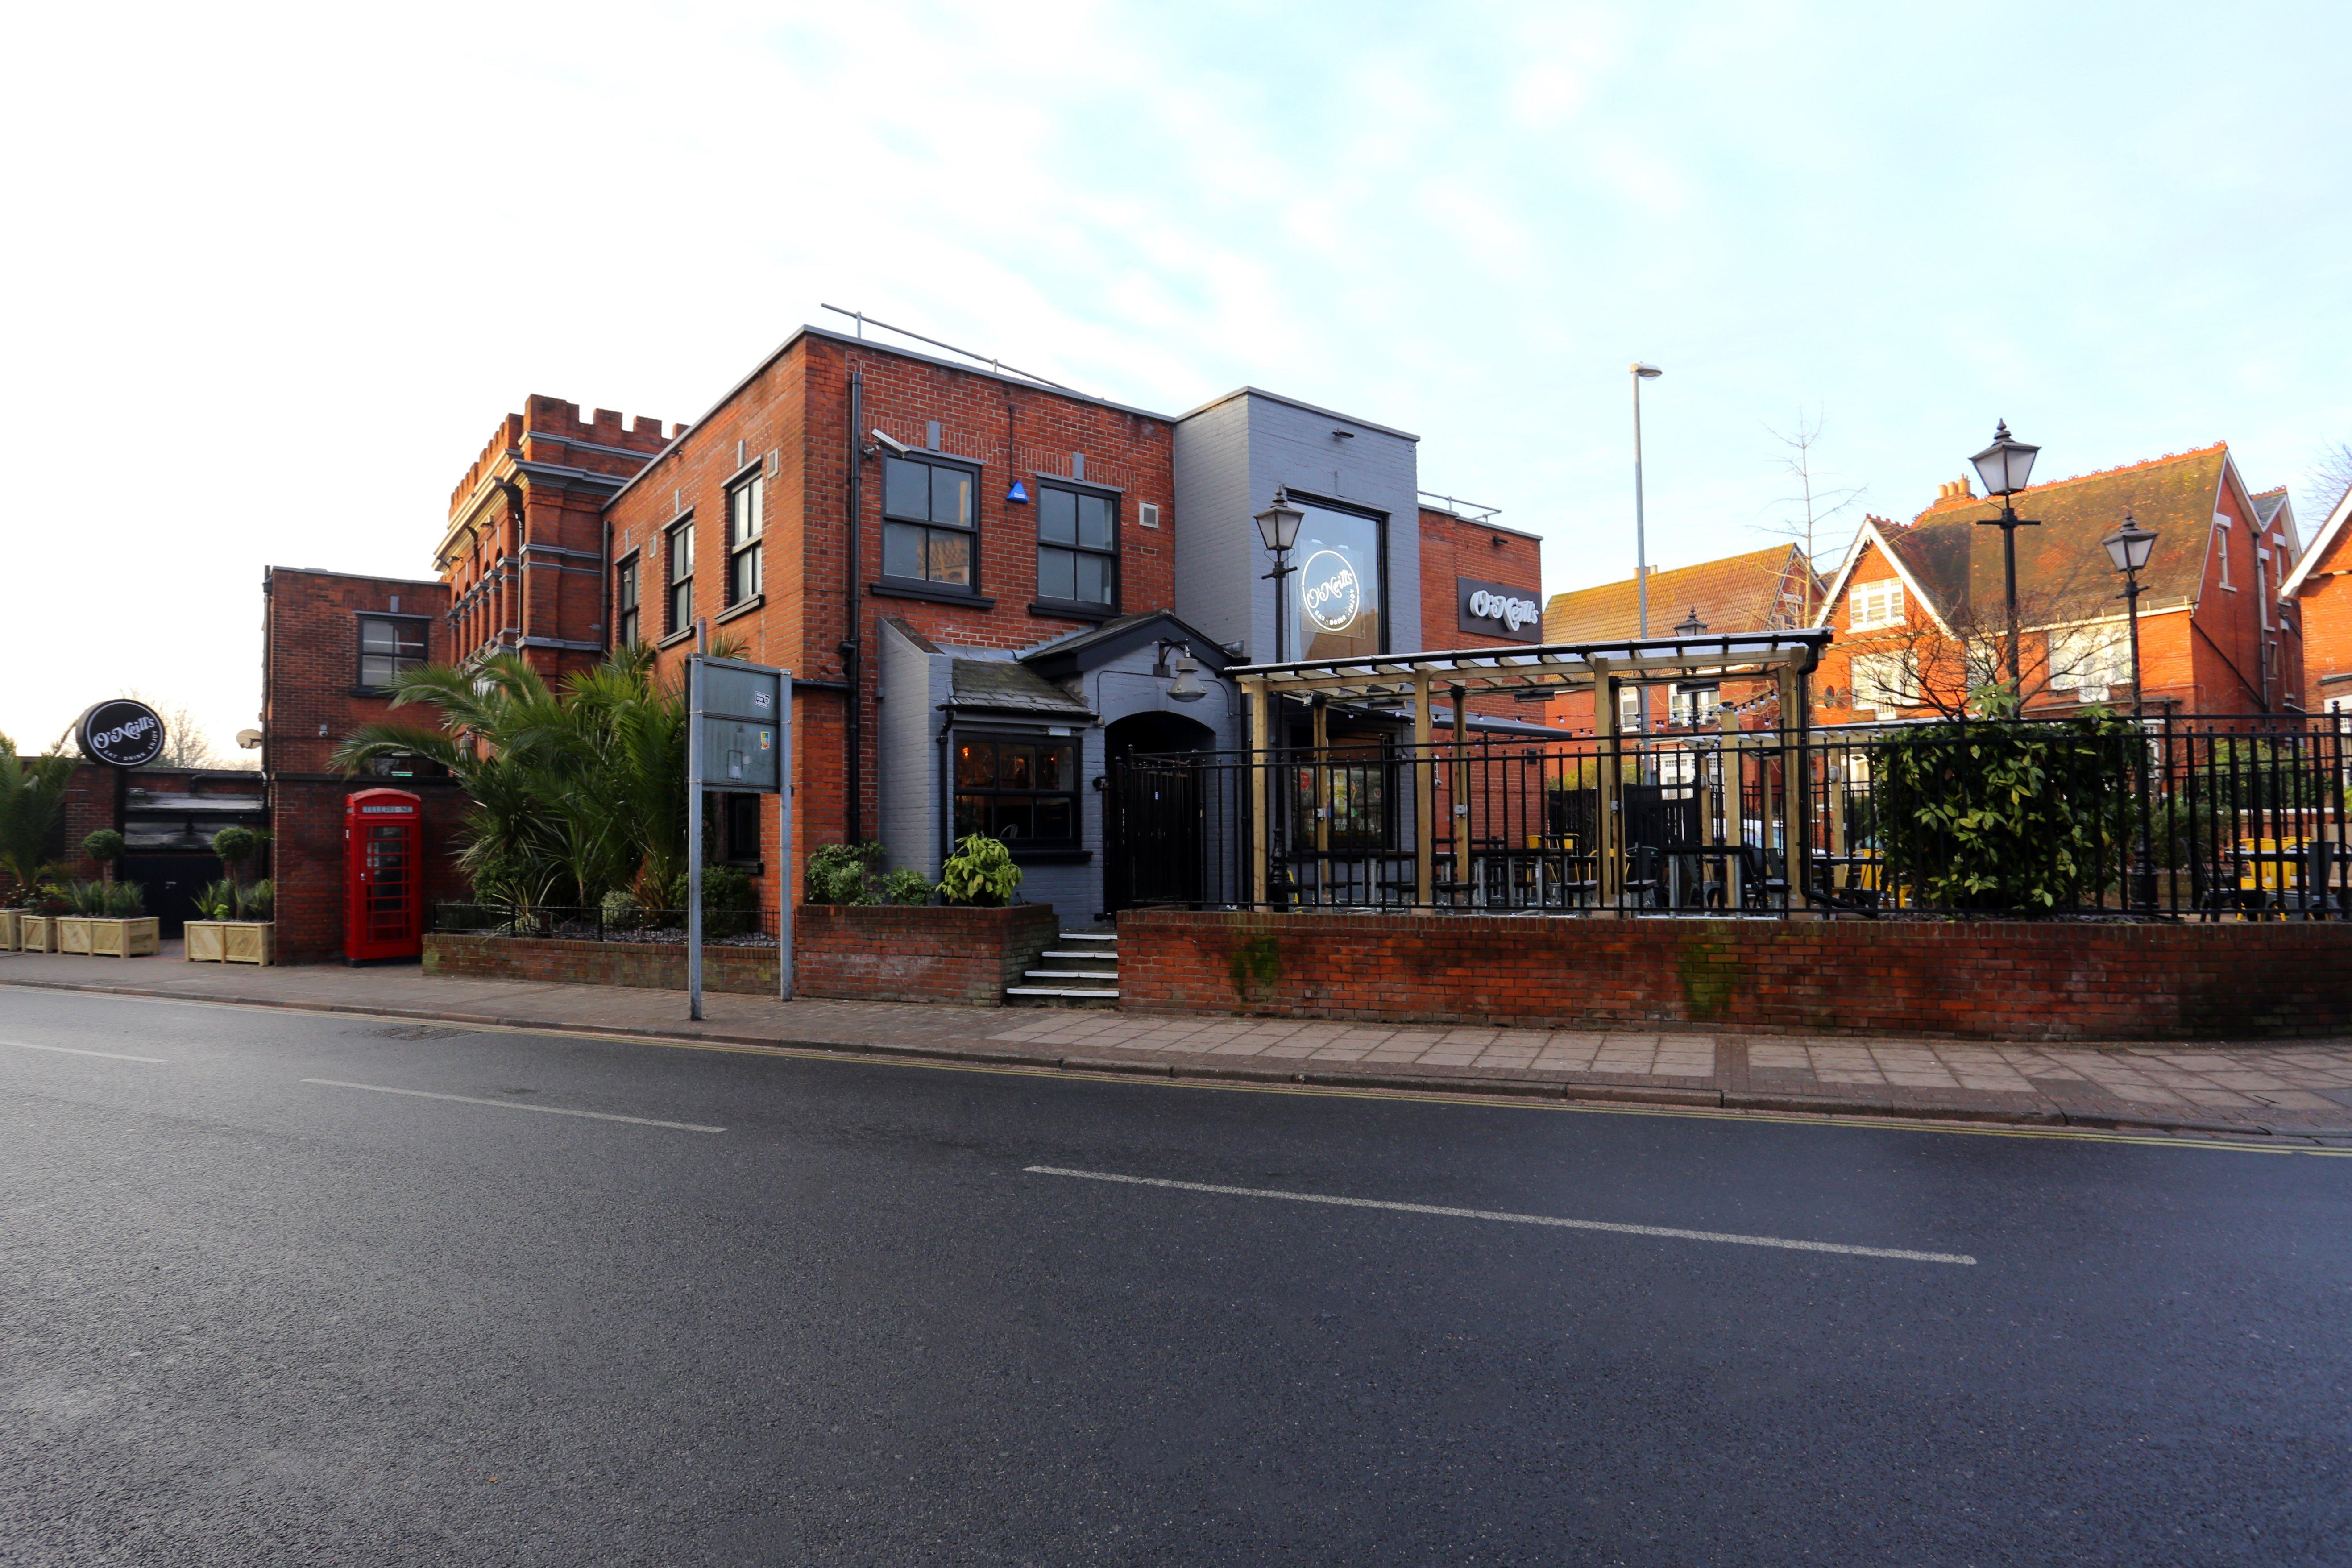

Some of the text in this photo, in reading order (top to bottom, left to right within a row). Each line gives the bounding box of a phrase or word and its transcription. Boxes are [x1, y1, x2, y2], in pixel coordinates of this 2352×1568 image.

[1307, 569, 1353, 608] O'Neill's
[1315, 610, 1326, 621] EAT
[1329, 615, 1347, 625] DRINK
[1470, 590, 1539, 631] O'Neill's
[93, 717, 155, 749] O'Neill's
[104, 730, 158, 760] EAT DRINK ENJOY
